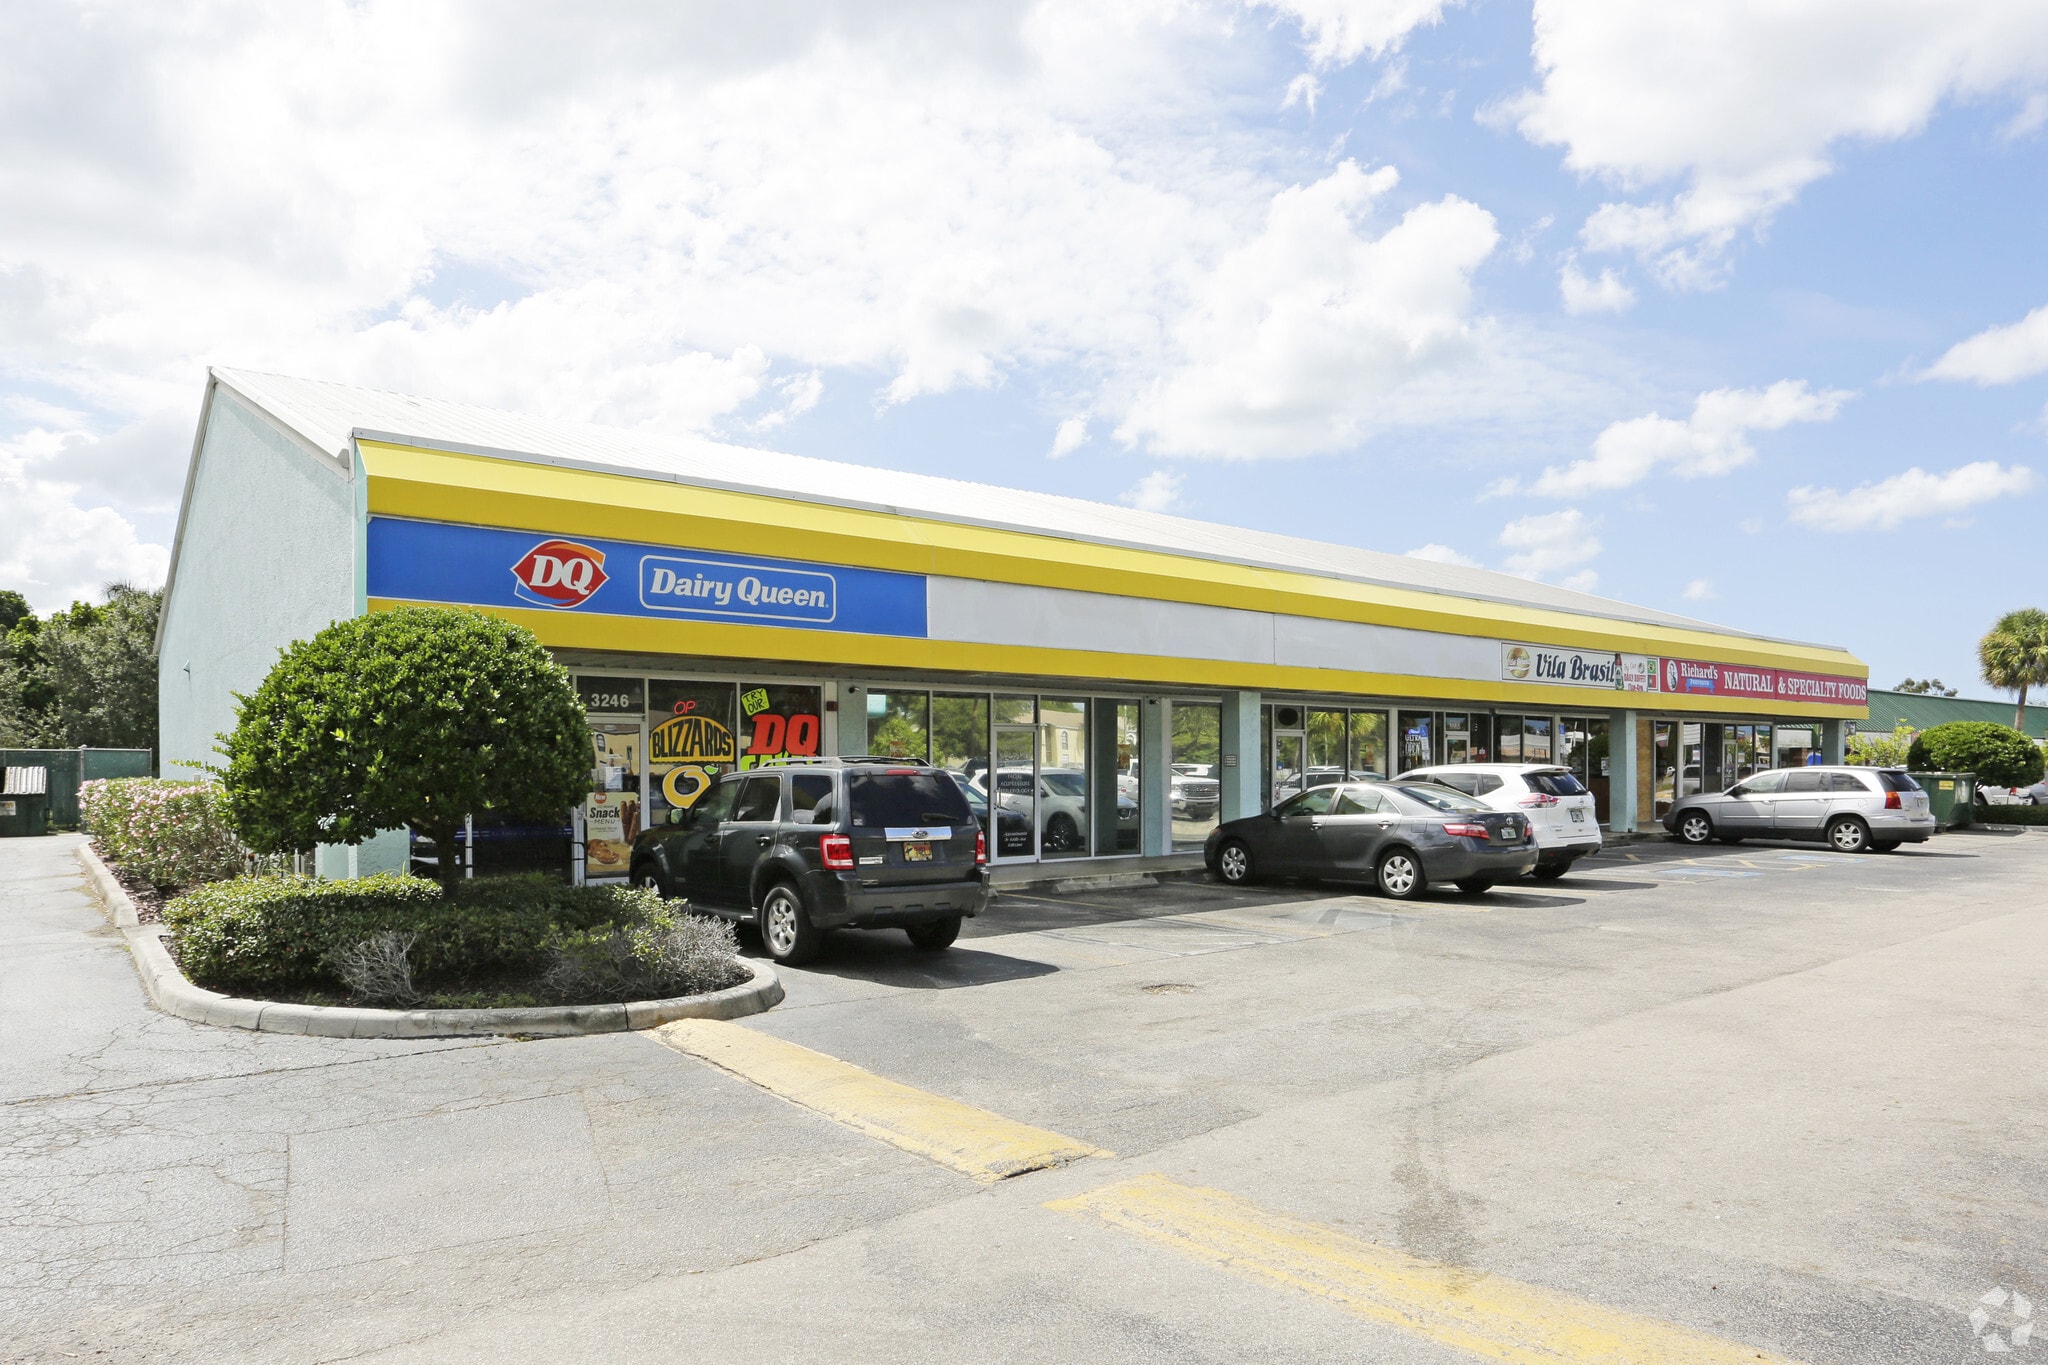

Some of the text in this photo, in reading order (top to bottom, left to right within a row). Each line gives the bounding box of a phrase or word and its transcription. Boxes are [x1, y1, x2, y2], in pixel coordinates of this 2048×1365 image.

[529, 554, 594, 595] DQ
[650, 568, 829, 608] Dairy Queen
[1536, 653, 1616, 682] Vila Brasil
[1681, 662, 1719, 679] Richard's
[744, 689, 762, 701] TRY
[1723, 671, 1866, 700] NATURAL & SPECIALTY FOODS
[591, 694, 629, 707] 3246
[747, 698, 764, 713] OUR
[653, 718, 732, 758] BLIZZARDS
[747, 714, 819, 756] DQ
[589, 806, 620, 818] Snack
